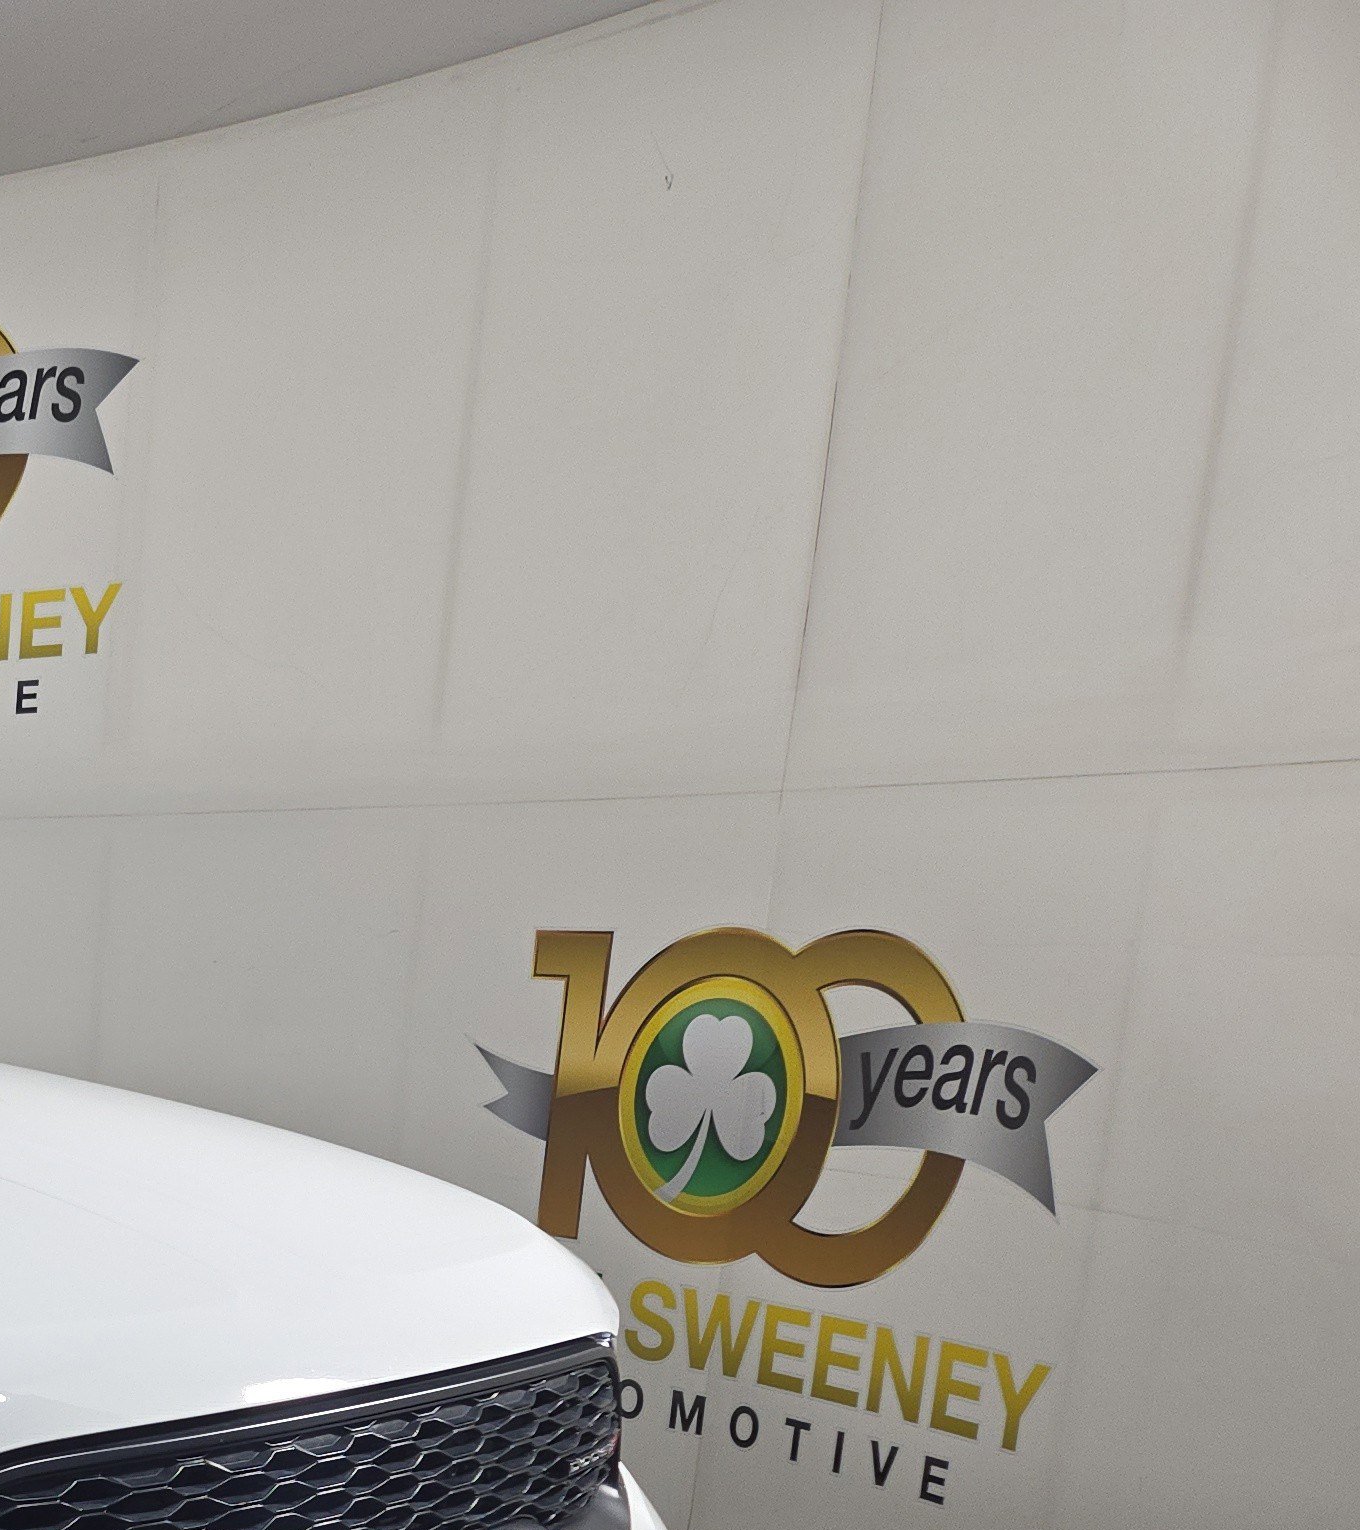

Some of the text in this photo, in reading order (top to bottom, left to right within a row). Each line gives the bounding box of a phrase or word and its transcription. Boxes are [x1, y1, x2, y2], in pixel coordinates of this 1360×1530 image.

[532, 926, 966, 1289] 100
[849, 1040, 1037, 1130] years
[624, 1280, 1051, 1453] SWEENEY
